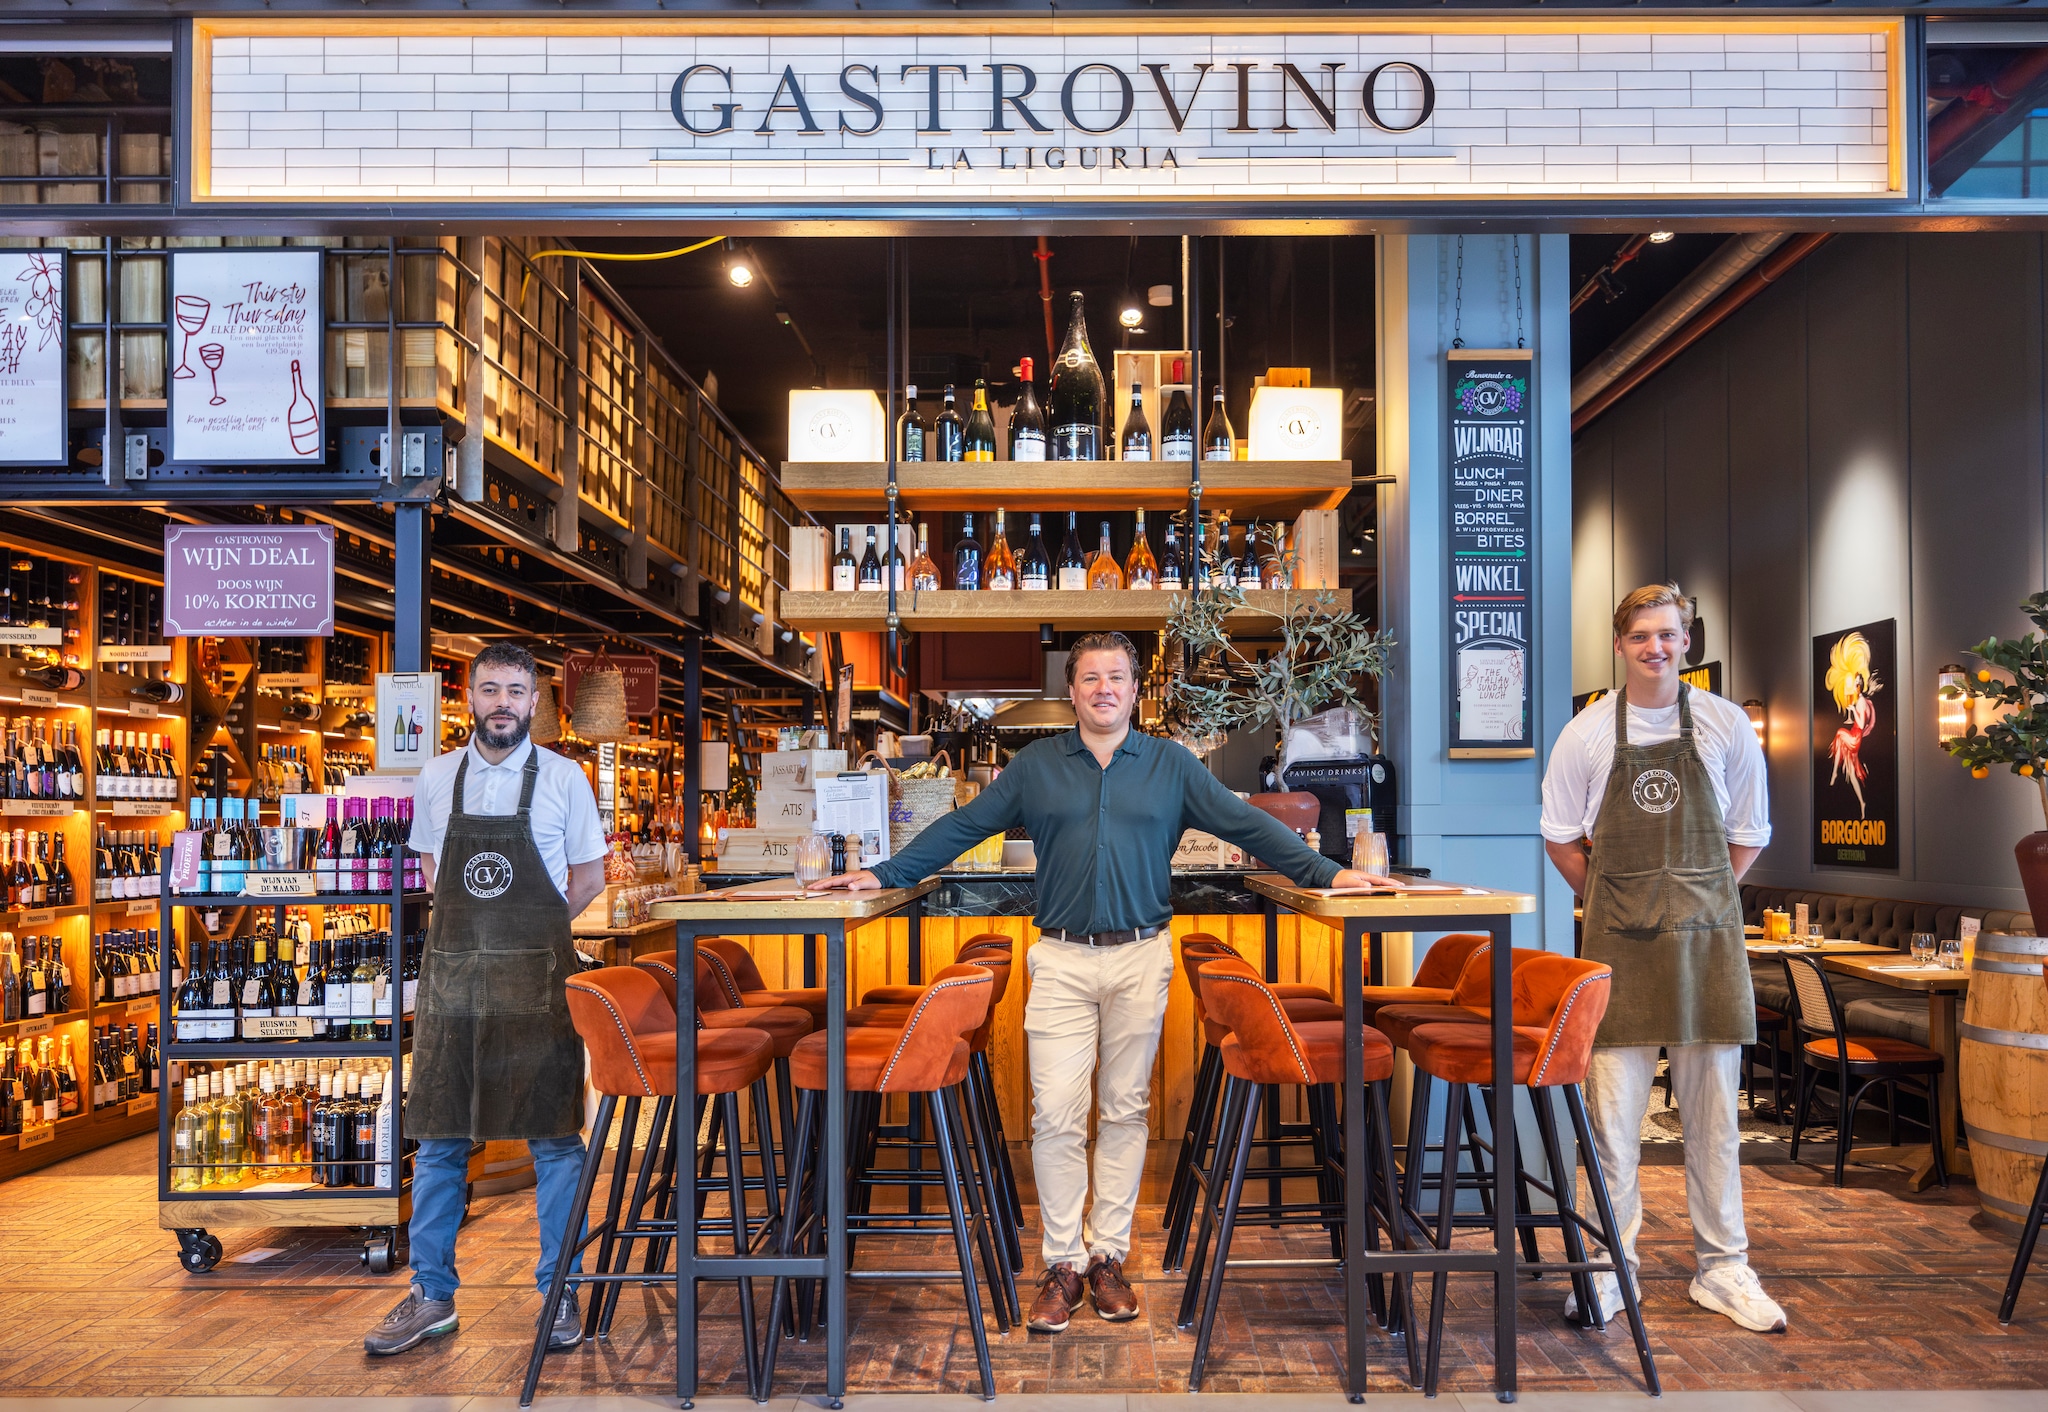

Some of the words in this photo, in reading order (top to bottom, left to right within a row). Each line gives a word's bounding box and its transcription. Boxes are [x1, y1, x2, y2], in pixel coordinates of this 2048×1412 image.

[669, 62, 1437, 137] GASTROVINO
[926, 146, 974, 172] LA
[999, 146, 1183, 172] LIGURIA
[242, 281, 307, 305] Thirsty
[222, 301, 307, 326] Thursday
[210, 325, 237, 335] ELKE
[239, 324, 305, 335] DONDERDAG
[1479, 391, 1499, 405] GV
[186, 414, 206, 425] Kom
[208, 414, 242, 427] gezellig
[245, 414, 267, 426] langs
[270, 416, 280, 424] en
[202, 422, 228, 433] proost
[1454, 426, 1524, 458] WIJNBAR
[1454, 467, 1505, 480] LUNCH
[1475, 488, 1524, 502] DINER
[1454, 512, 1515, 525] BORREL
[215, 535, 283, 545] GASTROVINO
[1477, 534, 1525, 548] BITES
[182, 547, 242, 571] WIJN
[249, 547, 316, 566] DEAL
[1455, 565, 1525, 592] WINKEL
[217, 579, 252, 590] DOOS
[254, 579, 284, 592] WIJN
[184, 594, 220, 610] 10%
[224, 593, 317, 610] KORTING
[204, 617, 237, 628] achter
[239, 618, 250, 627] in
[252, 617, 263, 627] de
[265, 616, 298, 628] winkel
[1454, 611, 1527, 644] SPECIAL
[0, 632, 37, 640] OUSSEREND
[629, 666, 654, 674] onze
[1485, 668, 1502, 677] THE
[390, 682, 424, 690] WIJNDEAL
[1476, 675, 1510, 685] ITALIAN
[1476, 683, 1510, 693] SUNDAY
[1479, 692, 1506, 700] LUNCH
[1328, 768, 1363, 776] DRINKS
[1643, 782, 1669, 800] GV
[781, 803, 803, 817] ATIS
[1821, 819, 1887, 846] BORGOGNO
[762, 843, 789, 857] ATIS
[1185, 839, 1219, 856] Jacobo
[182, 837, 194, 880] PROEVEN!
[261, 876, 281, 885] WIJN
[282, 876, 298, 885] VAN
[474, 866, 501, 884] GV
[261, 884, 272, 893] DE
[272, 884, 301, 893] MAAND
[259, 1020, 298, 1028] HUISWIJN
[260, 1028, 298, 1036] SELECTIE
